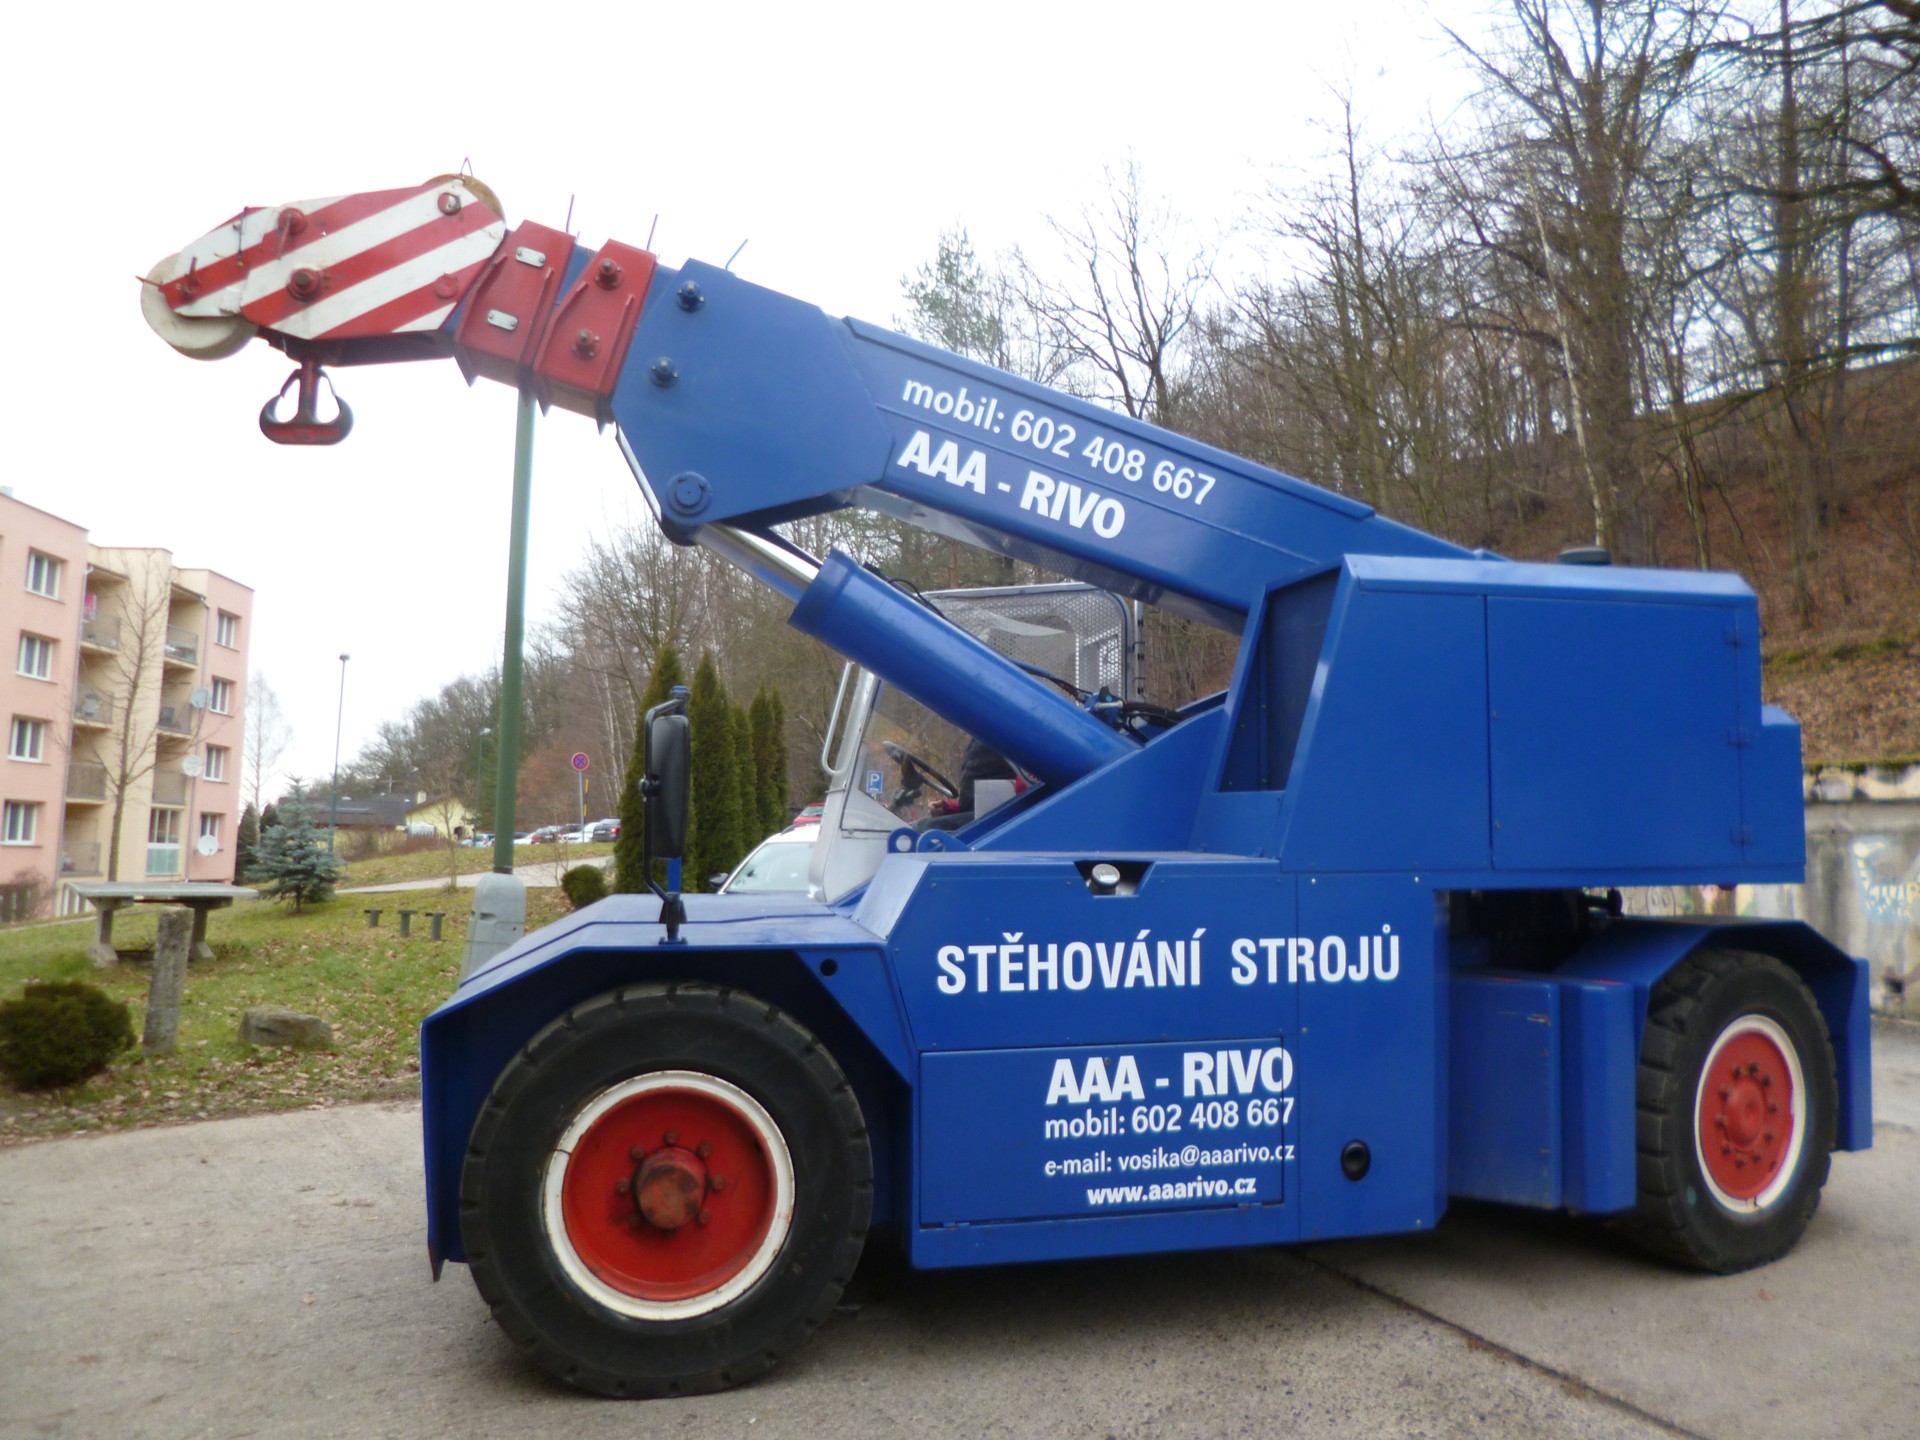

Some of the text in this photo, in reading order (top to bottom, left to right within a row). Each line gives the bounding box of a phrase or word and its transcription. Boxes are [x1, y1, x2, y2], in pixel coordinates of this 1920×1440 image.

[903, 379, 1216, 505] mobil: 602 408 667
[897, 430, 1126, 539] AAA - RIVO
[870, 773, 880, 786] P
[936, 924, 1400, 994] STĚHOVÁNÍ STROJŮ
[1045, 1047, 1294, 1105] AAA - RIVO
[1045, 1097, 1295, 1139] mobil: 602 408 667
[1044, 1142, 1295, 1176] e-mail: vosika@aaarivo.cz
[1087, 1175, 1257, 1205] www.aaarivo.cz
